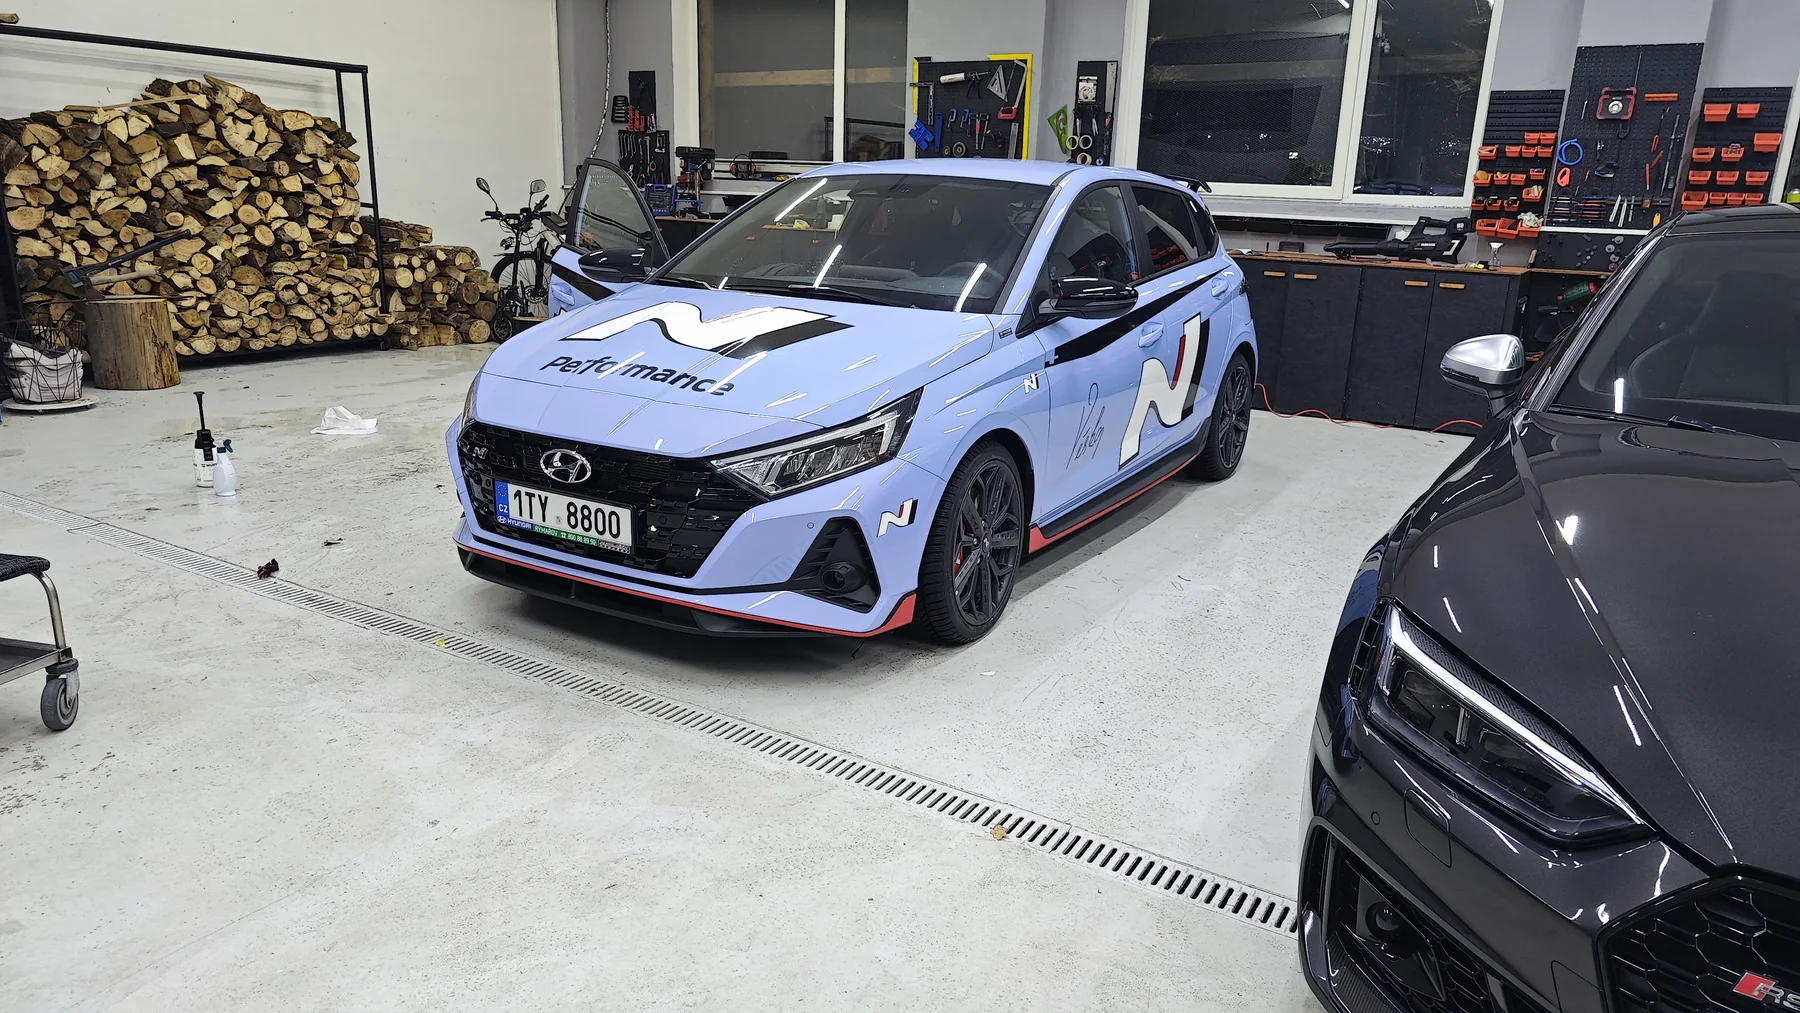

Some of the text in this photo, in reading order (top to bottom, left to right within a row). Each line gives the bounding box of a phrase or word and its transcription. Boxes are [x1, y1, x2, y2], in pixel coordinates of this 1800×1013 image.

[539, 355, 735, 397] Performance
[498, 503, 508, 513] CZ
[514, 489, 621, 539] 1TY 8800
[508, 519, 532, 529] HYUNDAI
